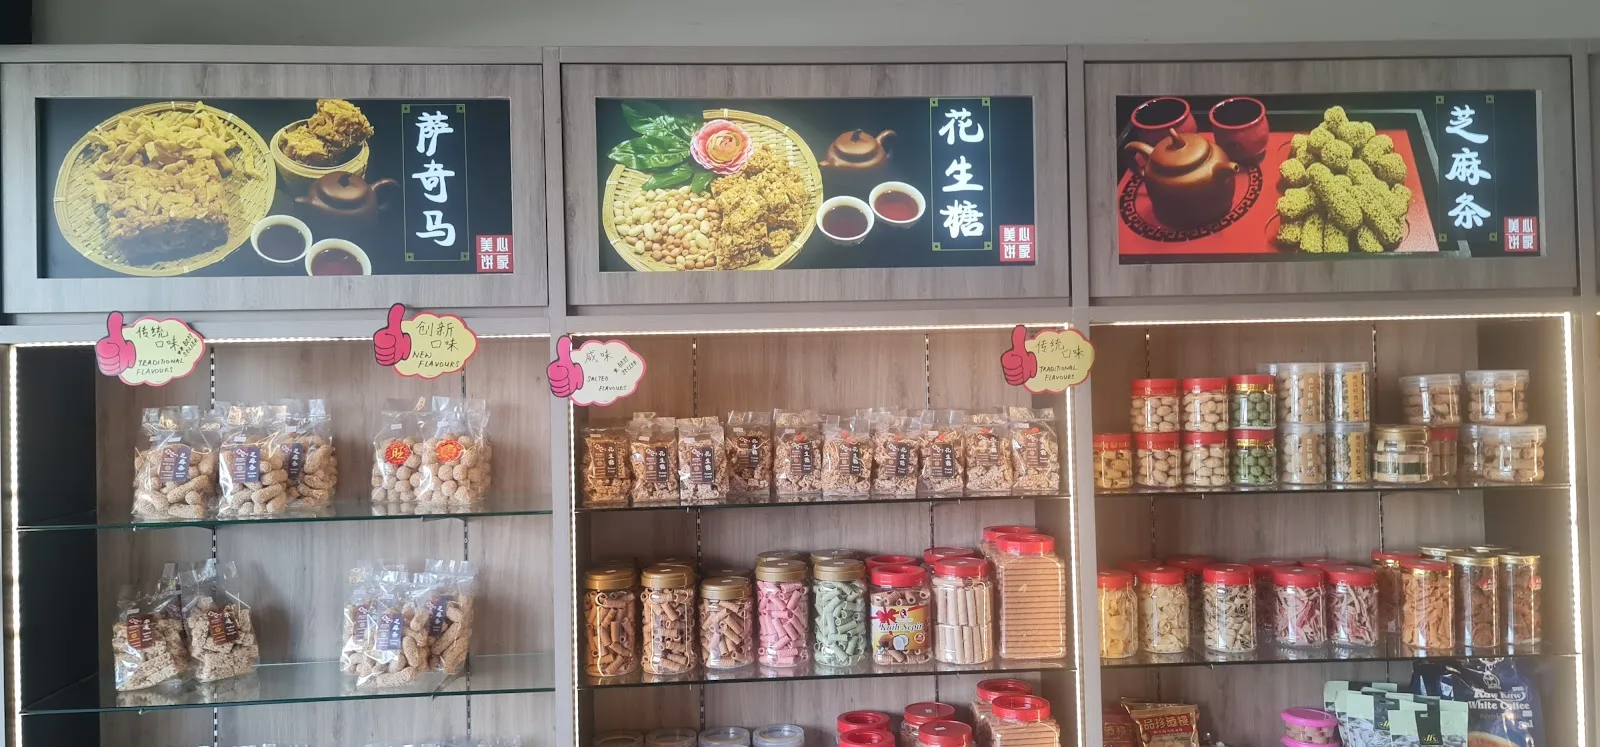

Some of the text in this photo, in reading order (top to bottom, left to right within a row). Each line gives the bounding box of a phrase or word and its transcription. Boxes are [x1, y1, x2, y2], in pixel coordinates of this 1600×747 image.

[938, 107, 985, 239] 花生糖
[1444, 104, 1492, 230] 芝麻条
[411, 110, 456, 247] 萨奇马
[136, 324, 169, 338] 传统
[416, 321, 454, 337] 创新
[154, 335, 179, 351] 口味
[430, 337, 459, 352] 口味
[1035, 338, 1065, 354] 传统
[412, 351, 433, 359] NEW
[584, 348, 613, 363] 咸味
[1061, 345, 1085, 359] 口味
[138, 358, 184, 367] TRADITIONAL
[418, 360, 460, 369] FLAVOURS
[1038, 365, 1079, 373] TRADITIONAL
[136, 367, 174, 376] FLAVOURS
[586, 375, 609, 383] SALTED
[880, 623, 900, 631] Kuih
[1468, 701, 1498, 710] White
